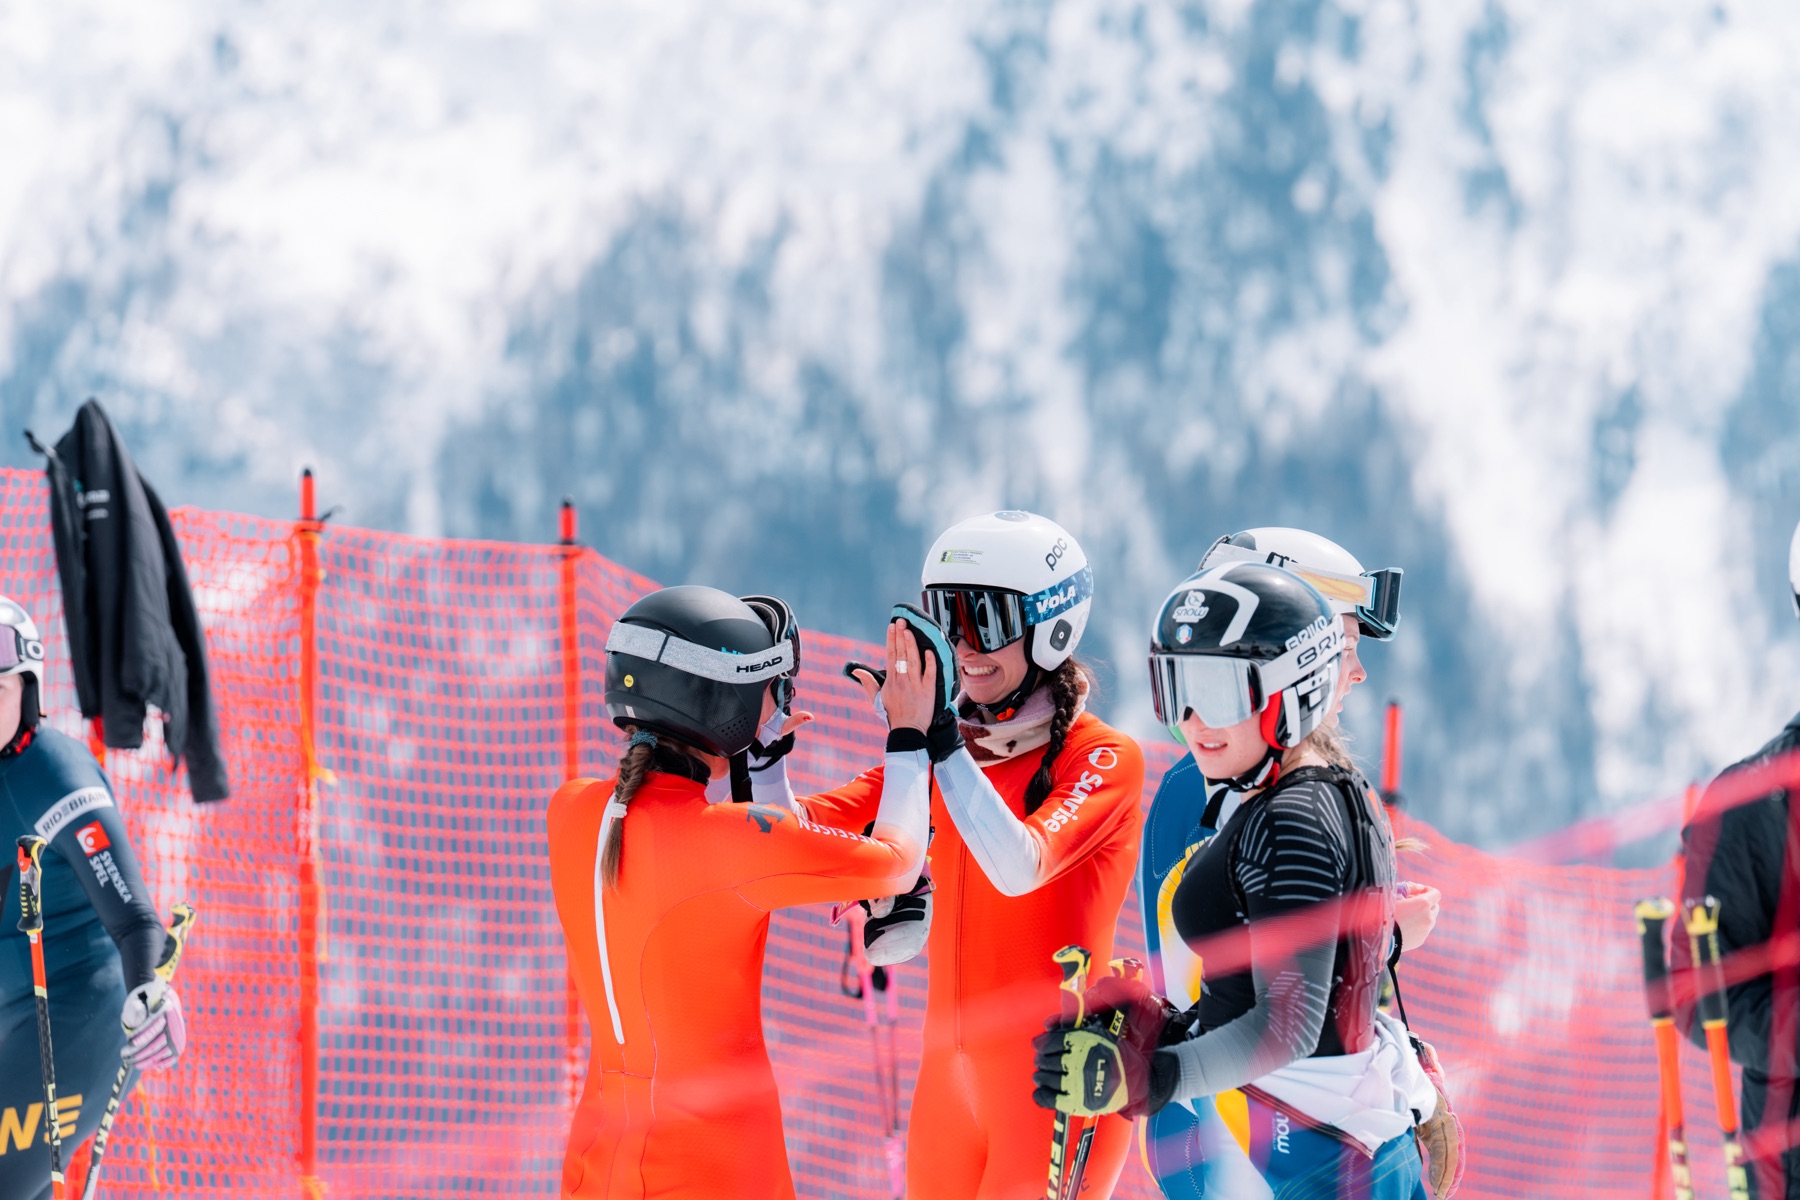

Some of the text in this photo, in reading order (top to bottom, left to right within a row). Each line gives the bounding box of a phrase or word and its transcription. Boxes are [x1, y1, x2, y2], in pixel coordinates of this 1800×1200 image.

[1036, 585, 1076, 614] VOLA
[736, 656, 783, 673] HEAD
[1297, 632, 1344, 669] BRI
[1043, 770, 1103, 833] Sunrise
[89, 856, 110, 888] SPEL
[99, 850, 133, 904] SVENSKA
[1094, 1059, 1106, 1097] LEKI
[47, 1083, 61, 1146] LEKI
[93, 1096, 120, 1155] LEKI
[1275, 1111, 1291, 1155] now
